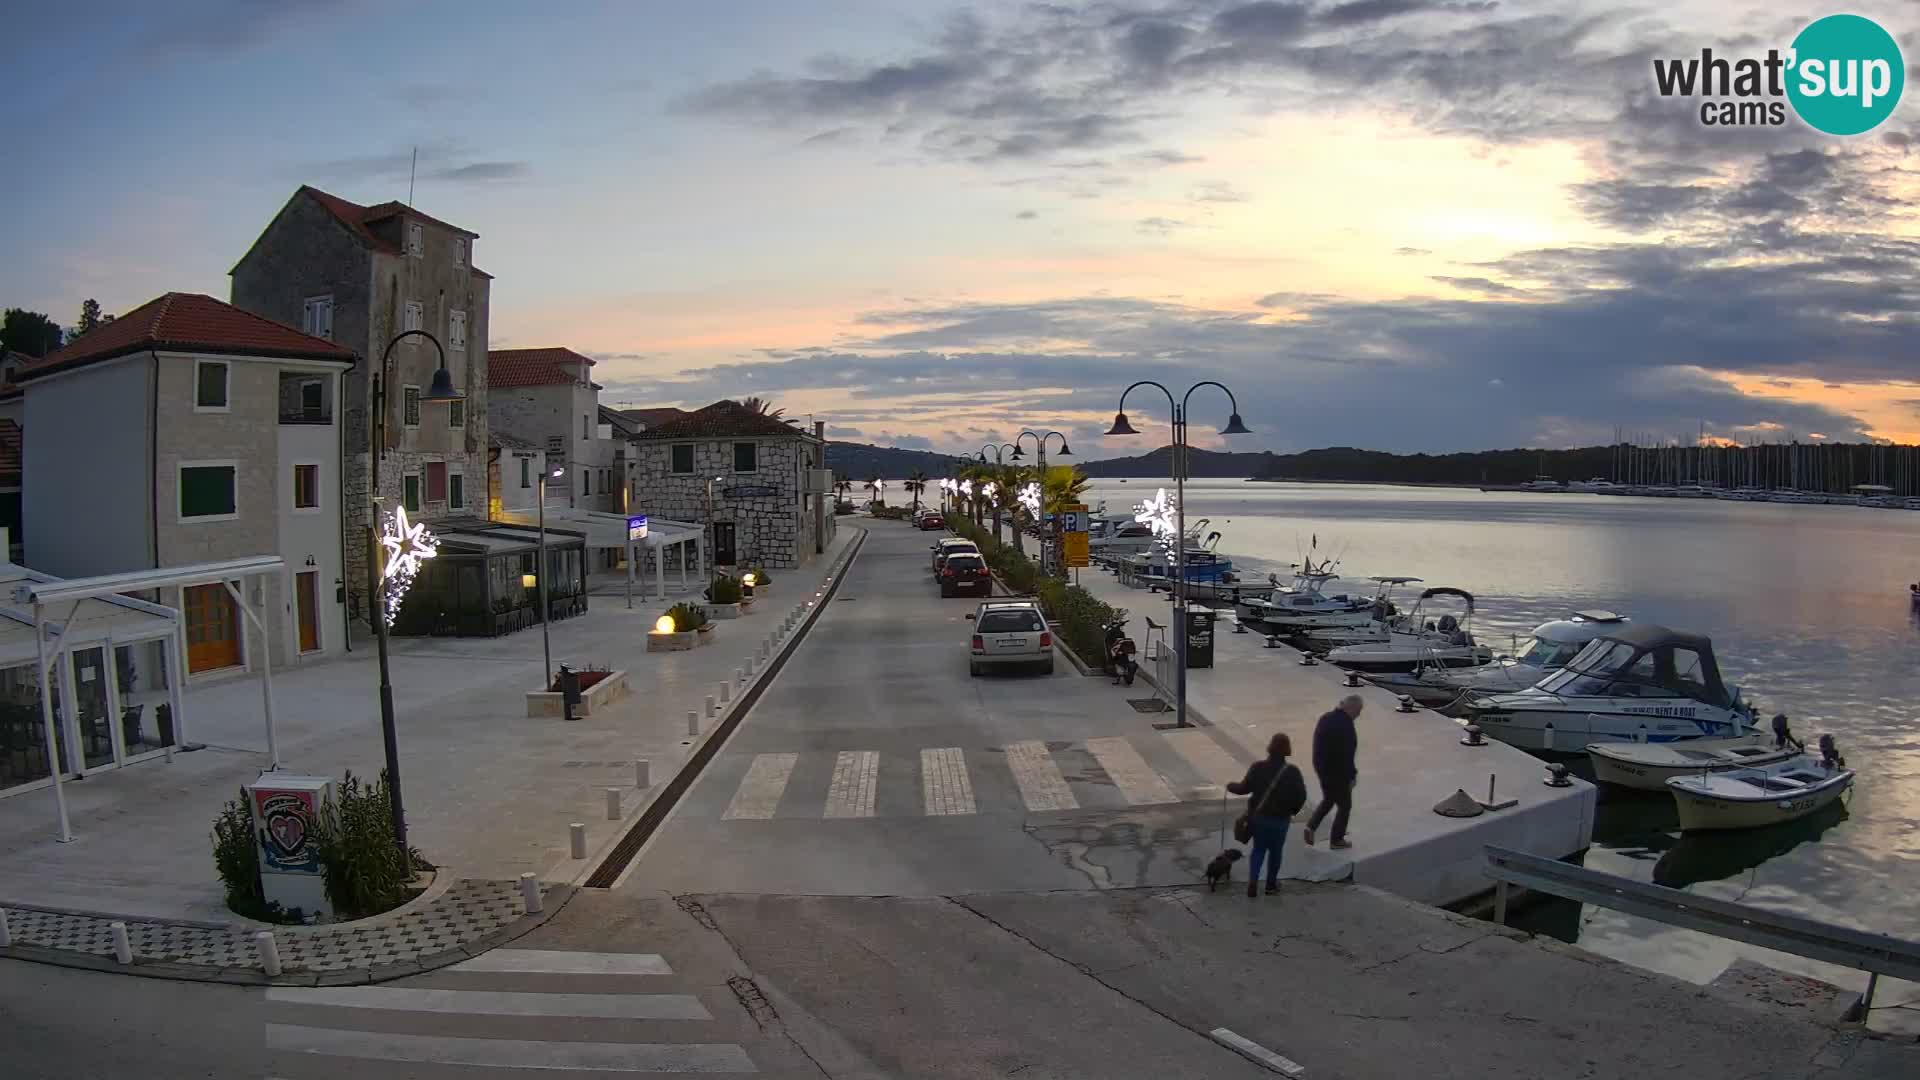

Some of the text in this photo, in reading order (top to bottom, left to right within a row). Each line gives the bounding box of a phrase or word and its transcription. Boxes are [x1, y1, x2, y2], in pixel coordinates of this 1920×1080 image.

[1065, 514, 1076, 530] P
[1655, 707, 1673, 716] RENT
[1679, 707, 1696, 717] BOAT
